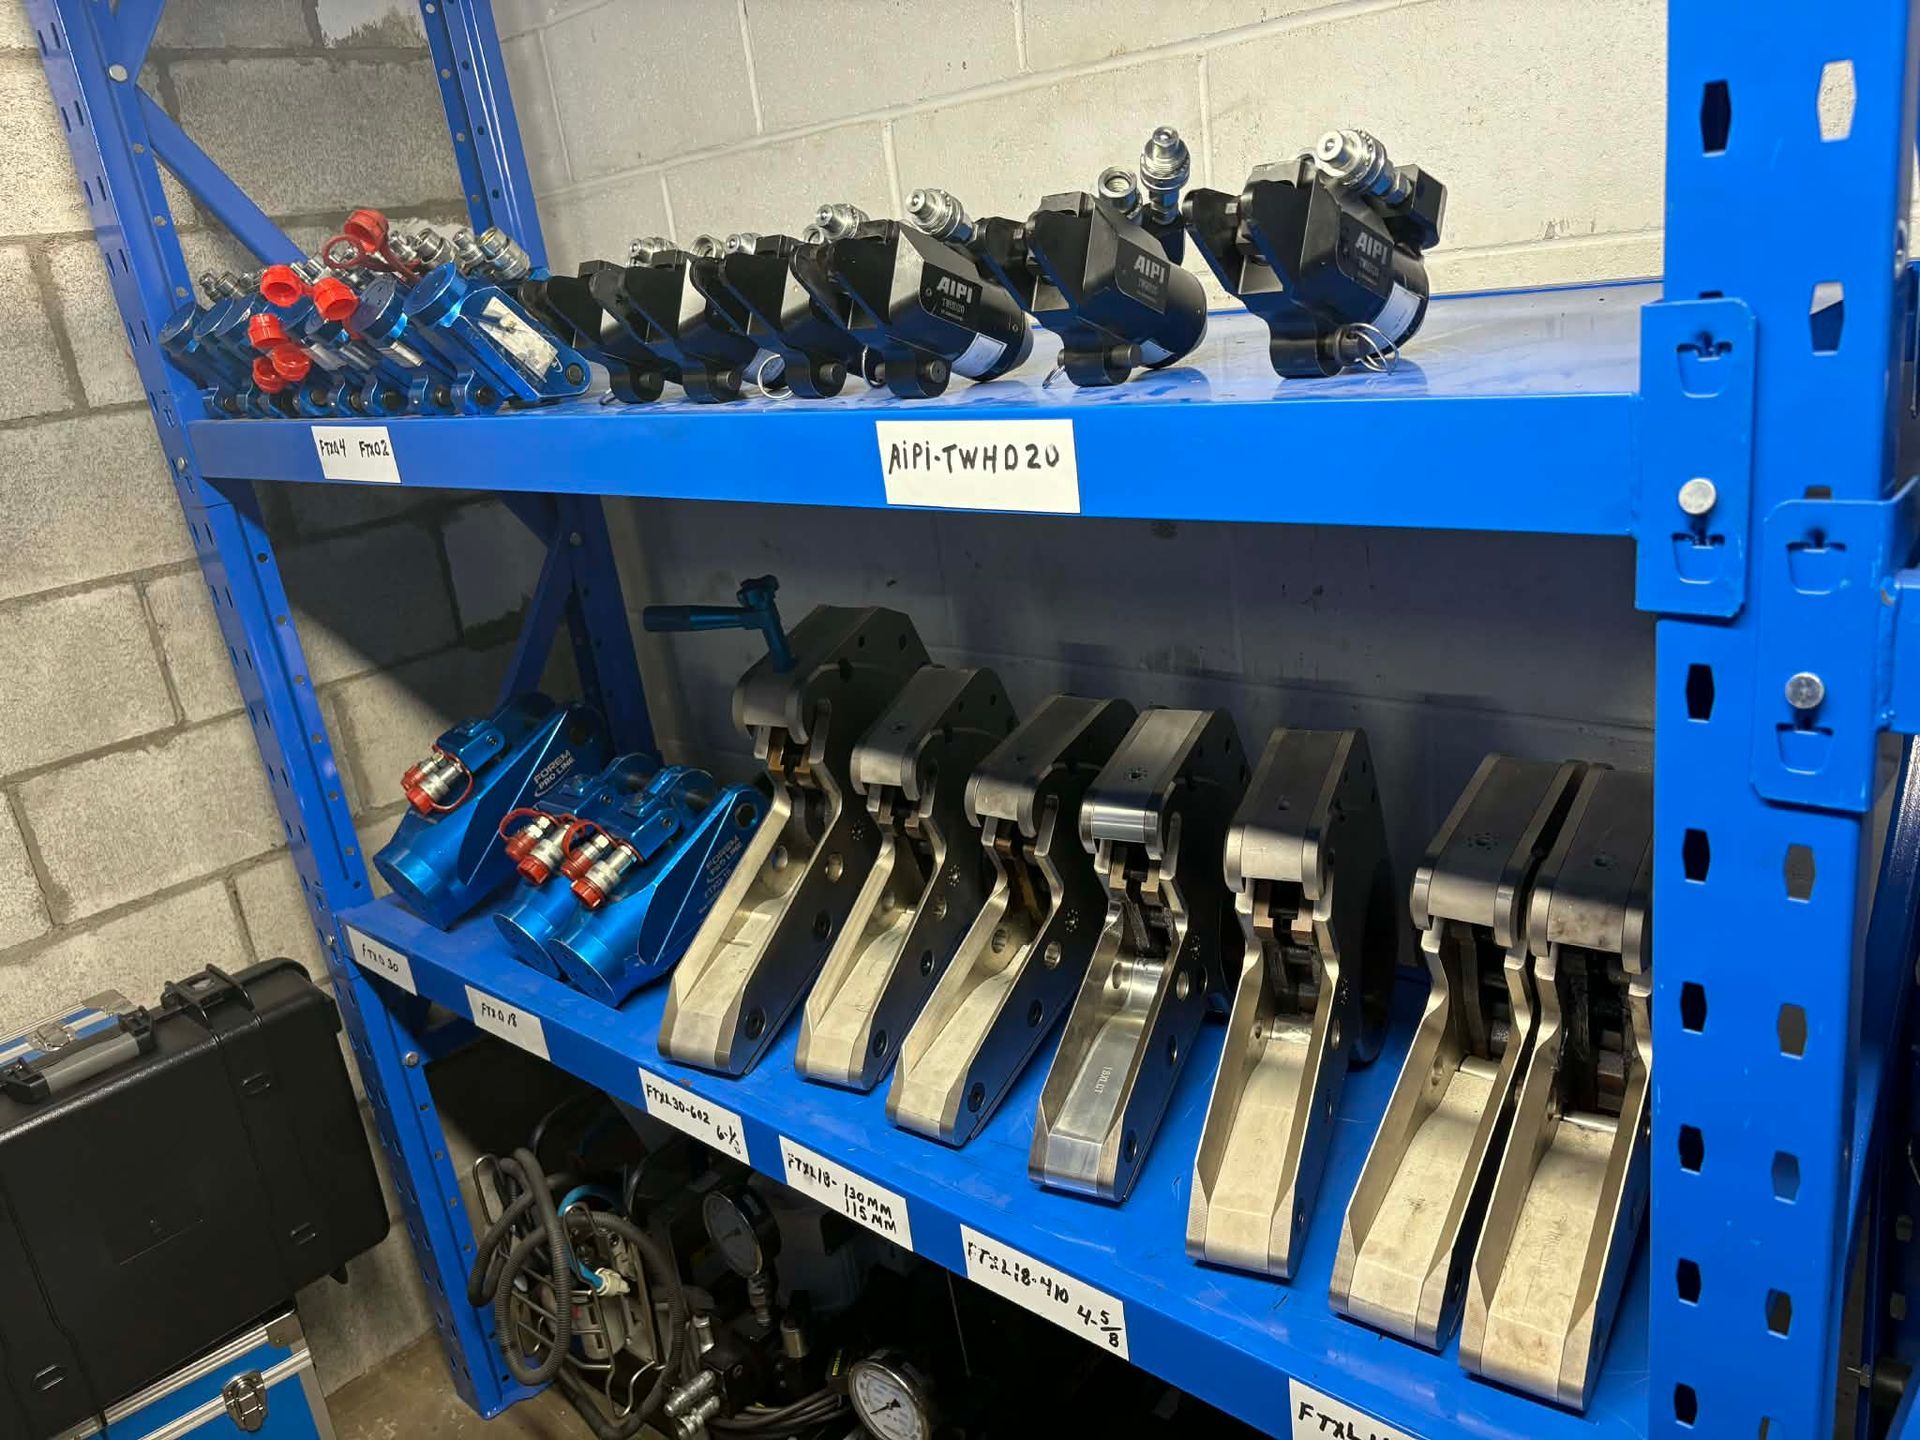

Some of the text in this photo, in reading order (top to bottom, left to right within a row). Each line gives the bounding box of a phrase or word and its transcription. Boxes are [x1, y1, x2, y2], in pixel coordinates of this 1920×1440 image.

[1355, 231, 1388, 265] AIPI
[1133, 254, 1166, 284] AIPI
[936, 275, 973, 304] AIPI
[534, 749, 571, 784] FOREM
[538, 773, 556, 790] PRO
[646, 1083, 711, 1126] FTXL30-602
